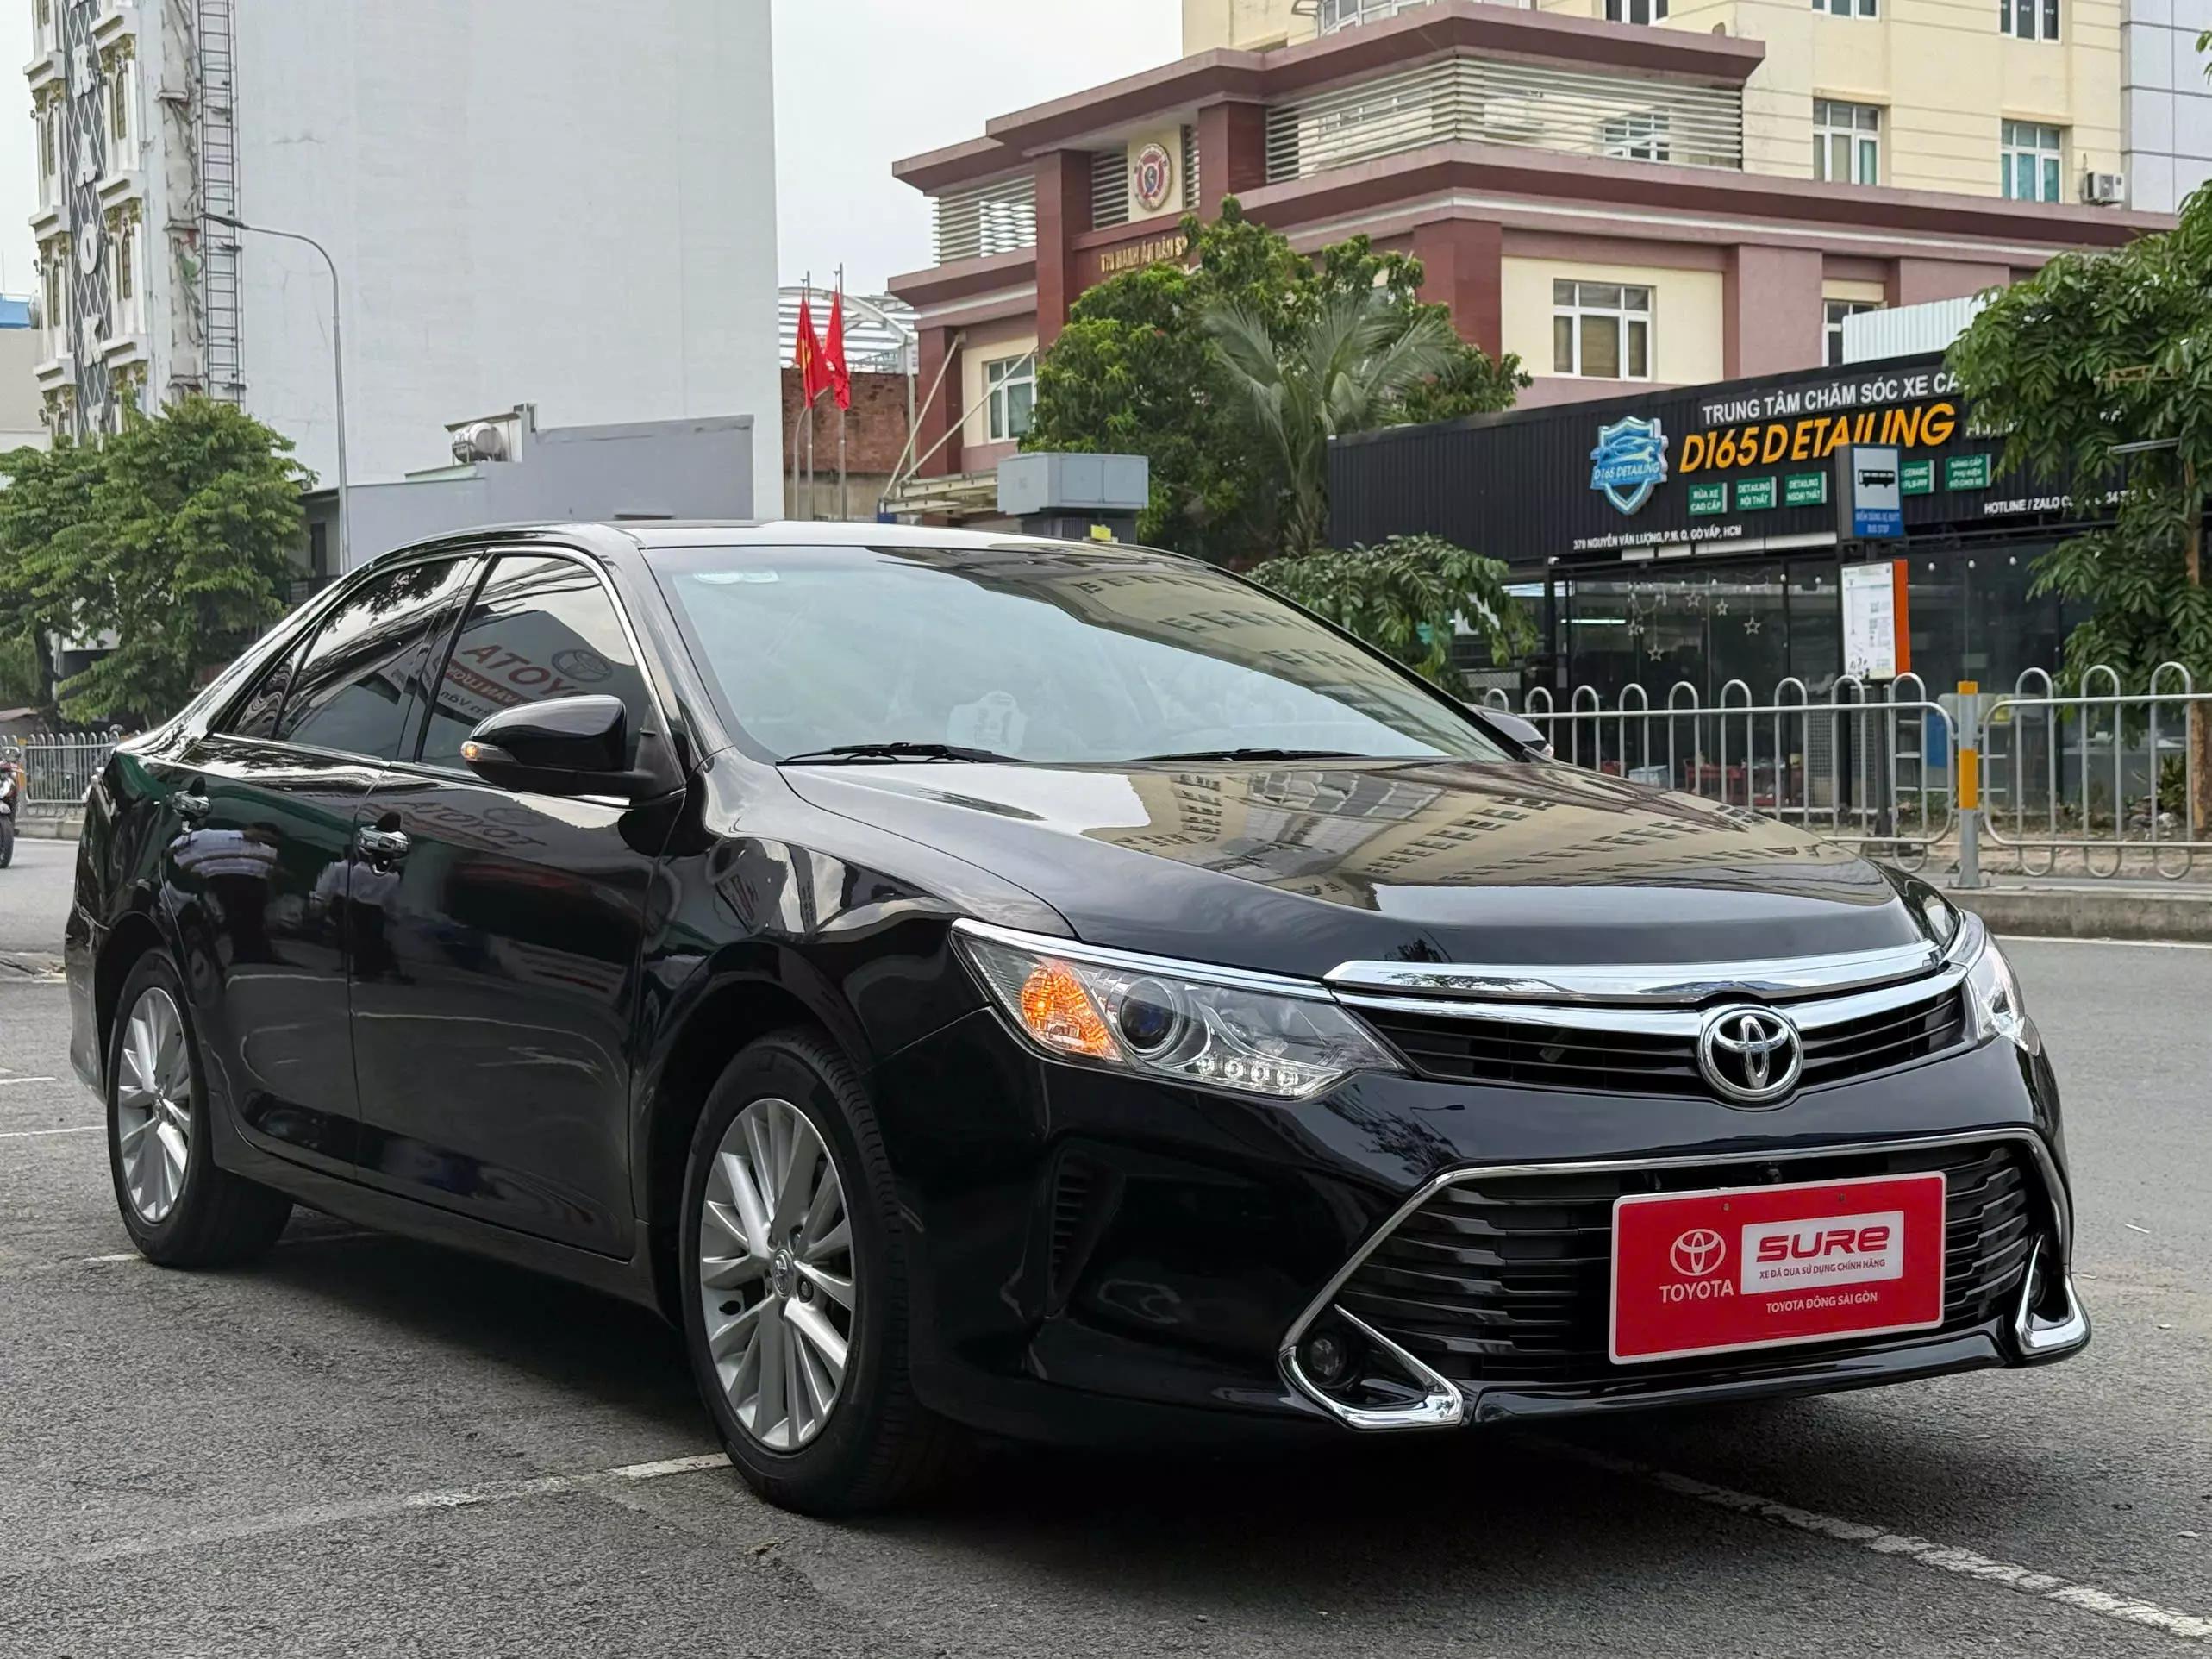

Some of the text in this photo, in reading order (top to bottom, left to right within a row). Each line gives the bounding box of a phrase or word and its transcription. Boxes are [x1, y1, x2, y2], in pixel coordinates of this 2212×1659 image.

[1703, 398, 1760, 425] TRUNG
[1764, 390, 1800, 416] TÂM
[1805, 382, 1856, 410] CHĂM
[1860, 376, 1897, 404] SÓC
[1903, 374, 1928, 398] XE
[1616, 461, 1659, 478] DETAILING
[1709, 489, 1719, 498] XE
[1690, 499, 1721, 511] CAO CẤP
[1984, 498, 2026, 515] HOTLINE
[2033, 496, 2060, 511] ZALO
[1587, 533, 1618, 549] NGUYỄN
[1690, 526, 1704, 541] GÒ
[1723, 524, 1742, 537] HCM
[1759, 1258, 1885, 1280] XE ĐÃ QUA SỬ DỤNG CHÍNH HÃNG
[1659, 1279, 1734, 1304] TOYOTA
[1766, 1288, 1878, 1314] TOYOTA ĐÔNG SÀI GÒN
